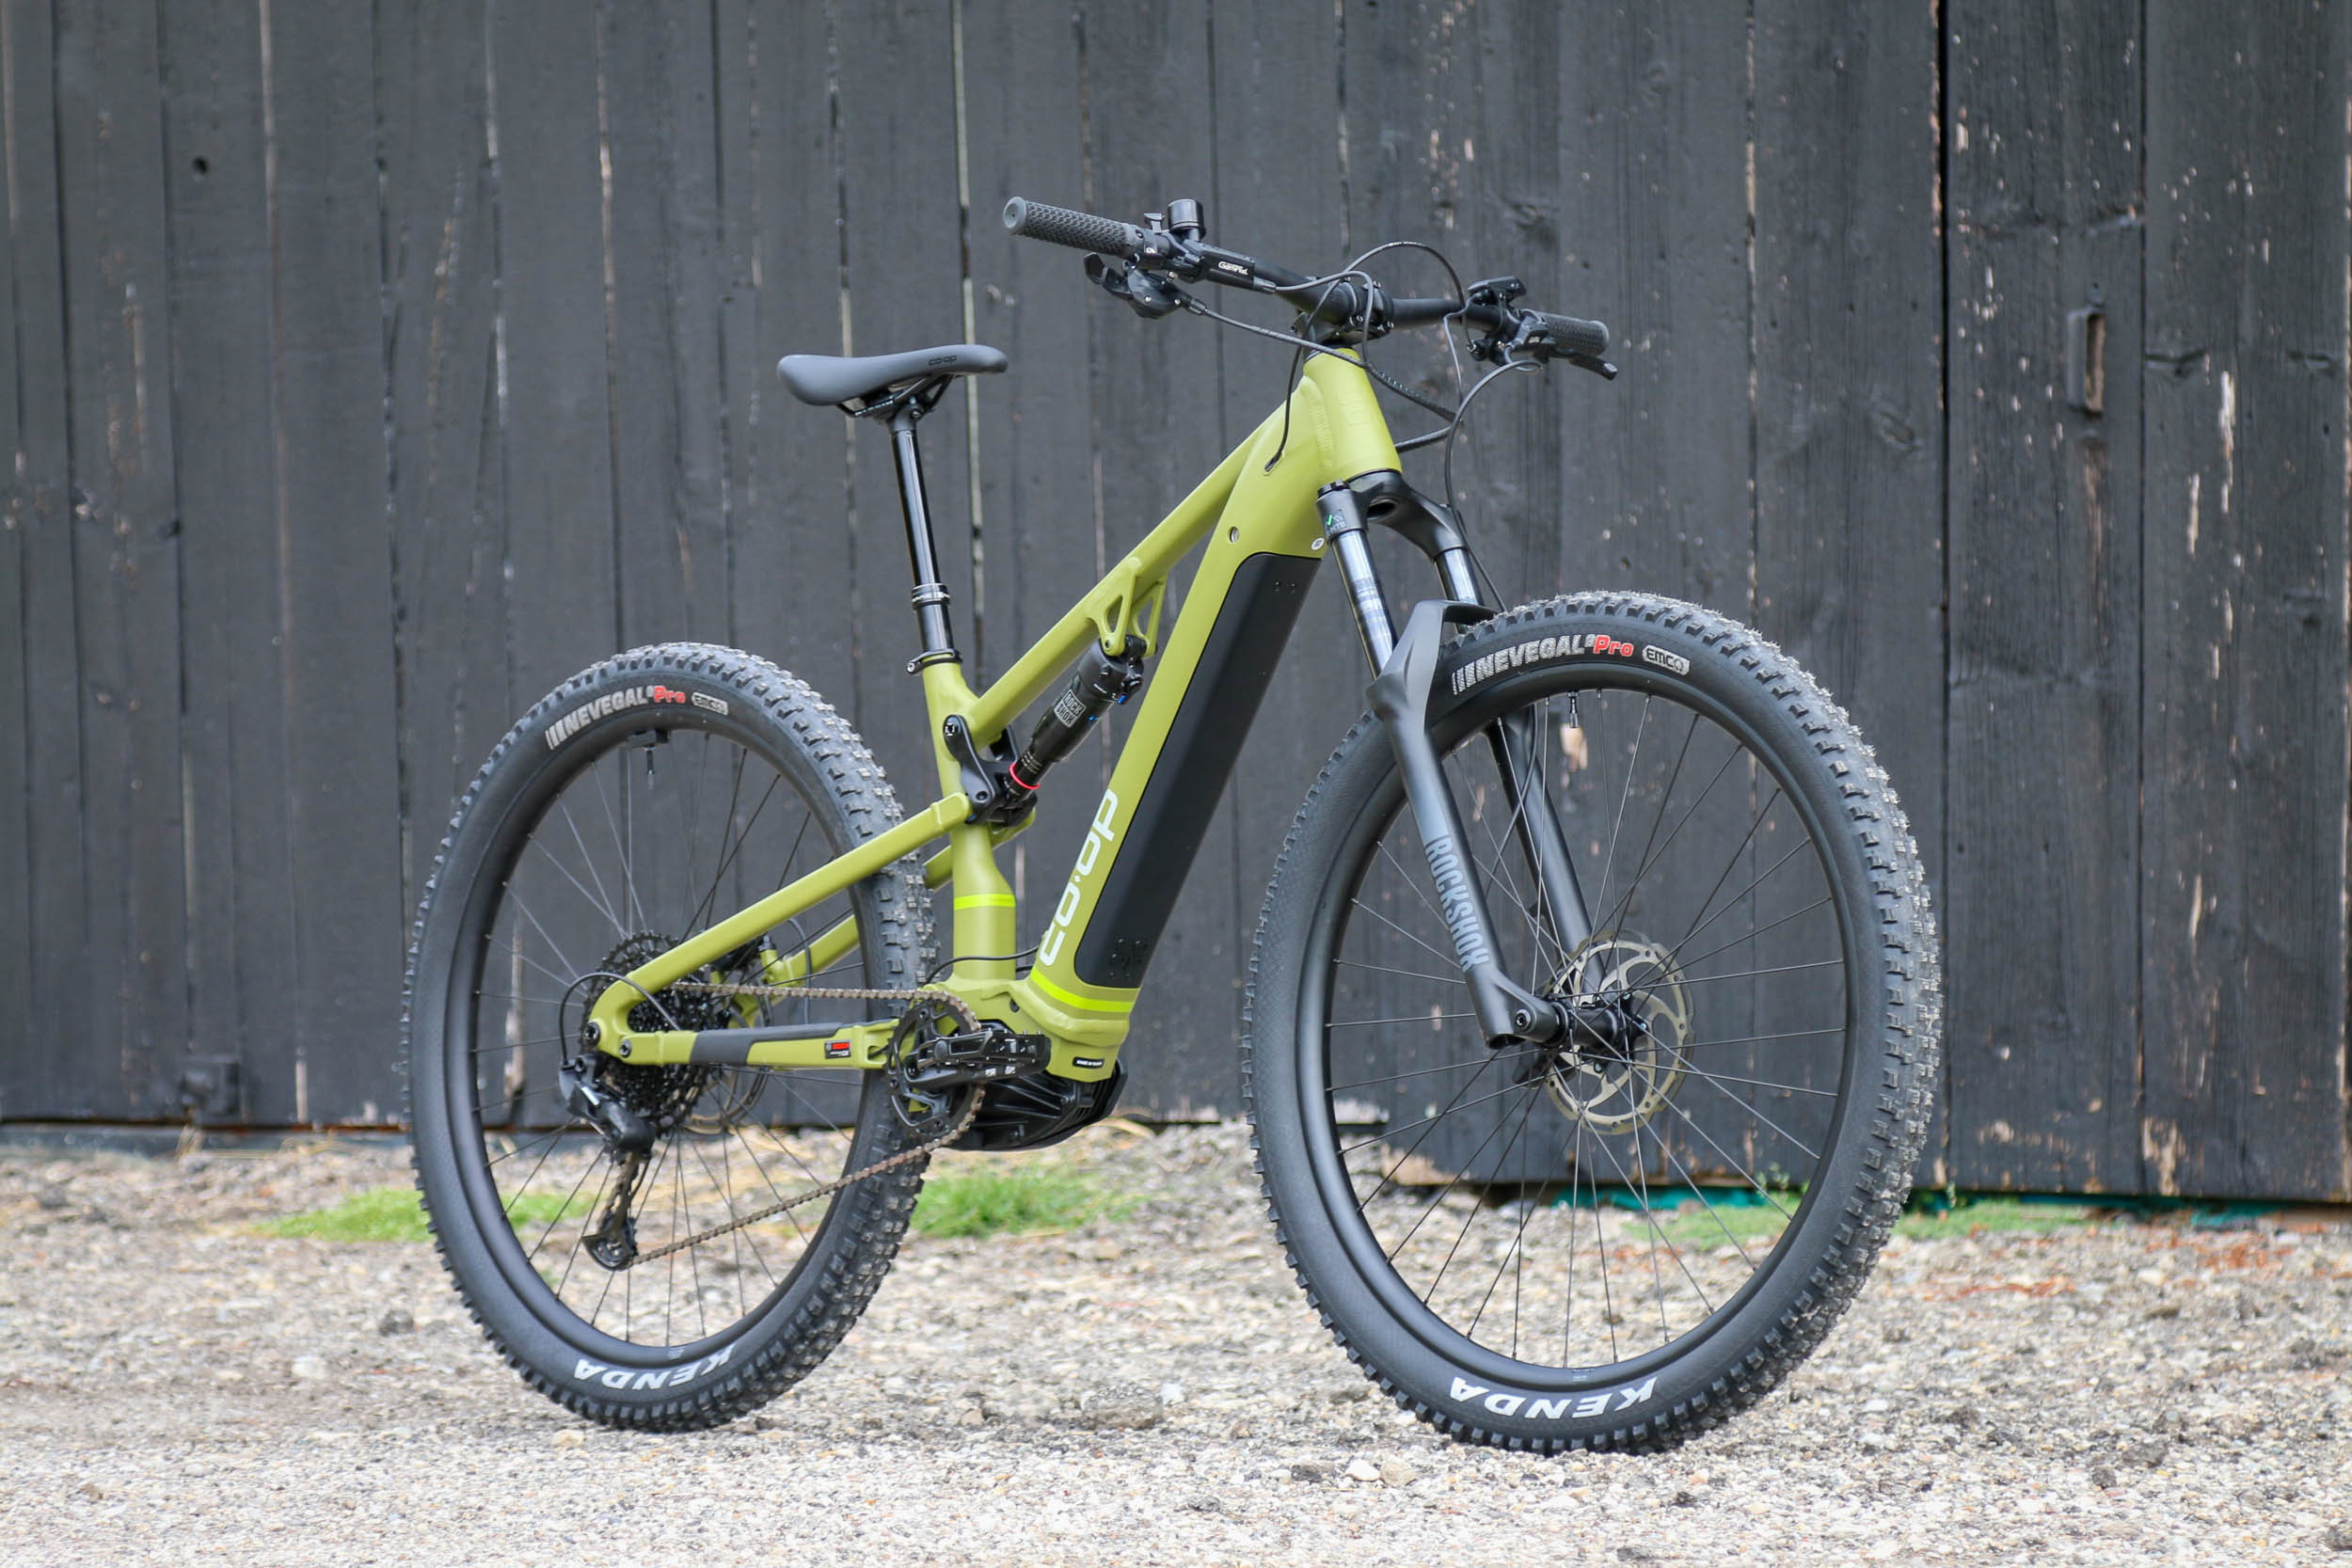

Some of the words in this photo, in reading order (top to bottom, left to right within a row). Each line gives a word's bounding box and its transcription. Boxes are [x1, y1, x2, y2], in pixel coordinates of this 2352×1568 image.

[1593, 634, 1635, 657] Pro
[653, 685, 686, 704] Pro
[1063, 692, 1083, 715] ROCK
[1057, 702, 1074, 724] SHOX
[1424, 836, 1491, 974] ROCKSHOX
[574, 1342, 737, 1391] KENDA
[1449, 1366, 1659, 1420] KENDA
